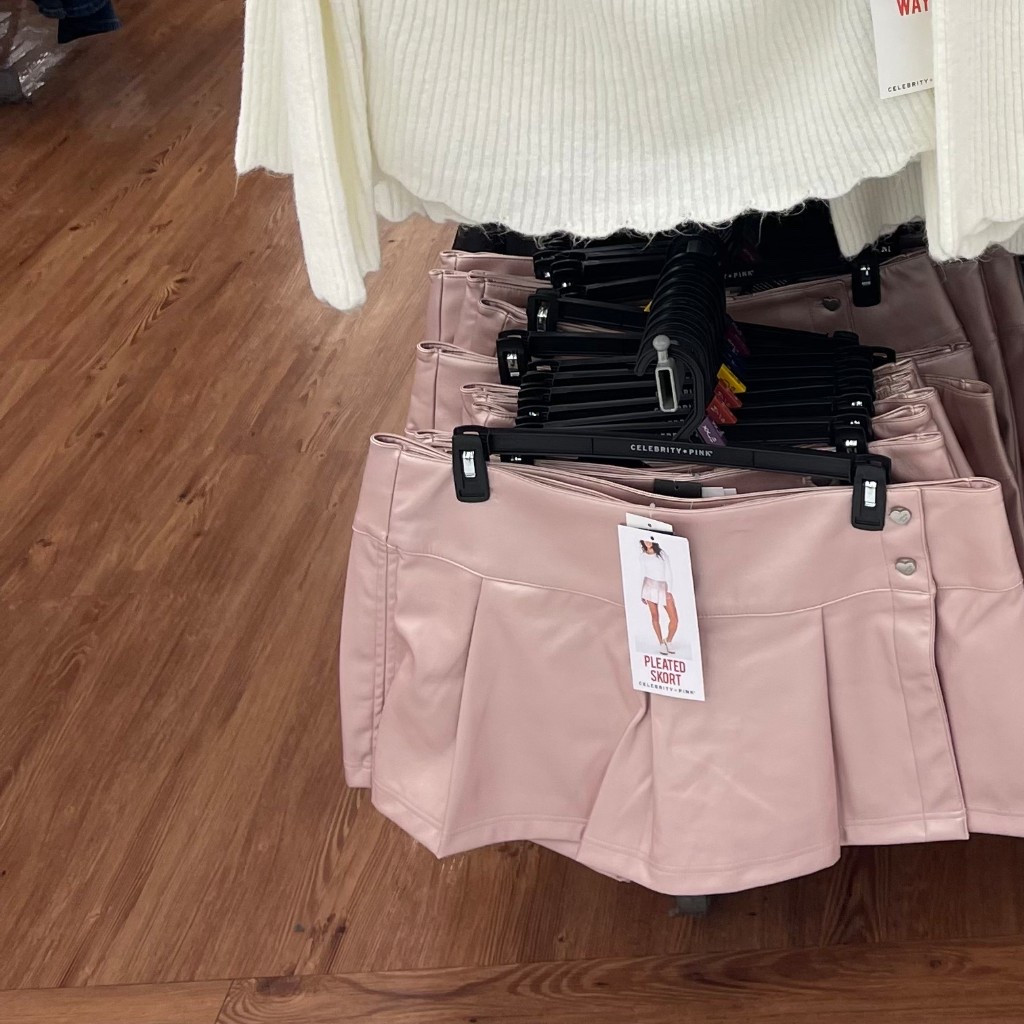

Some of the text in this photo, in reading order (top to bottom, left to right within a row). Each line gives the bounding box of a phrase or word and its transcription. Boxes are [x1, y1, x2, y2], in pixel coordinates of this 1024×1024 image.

[887, 78, 929, 93] CELEBRITY
[630, 443, 682, 454] CELEBRITY
[643, 654, 686, 673] PLEATED
[650, 669, 682, 687] SKORT
[638, 680, 673, 692] CELEBRITY
